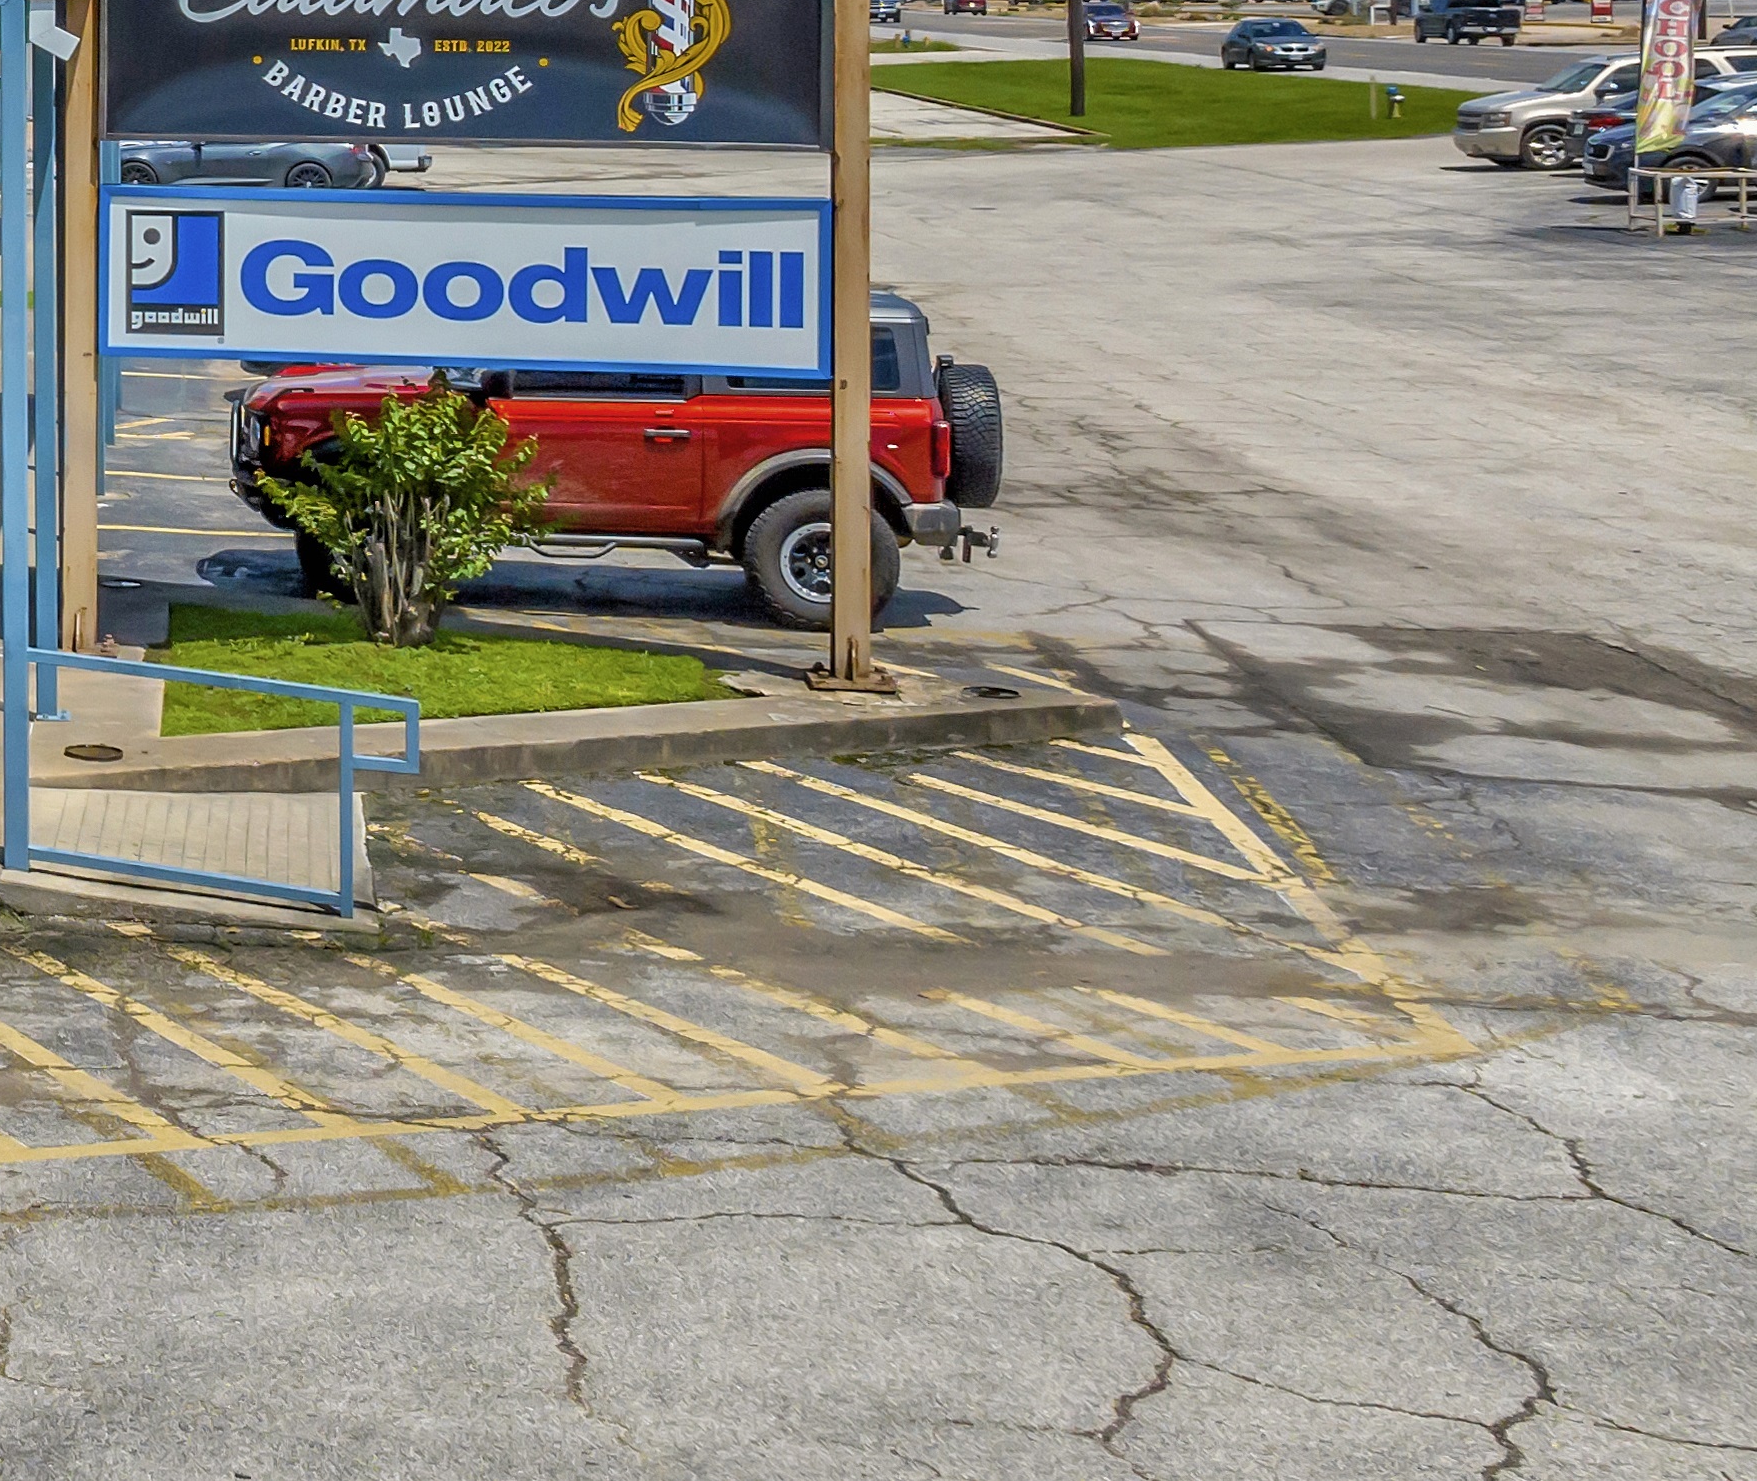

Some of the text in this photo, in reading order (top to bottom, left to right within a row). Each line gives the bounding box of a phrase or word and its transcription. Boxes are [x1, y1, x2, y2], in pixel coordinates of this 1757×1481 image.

[349, 39, 367, 51] TX
[476, 40, 510, 53] 2022
[261, 60, 534, 129] BARBER LOUNGE
[239, 239, 805, 330] Goodwill
[131, 307, 219, 330] goodwill
